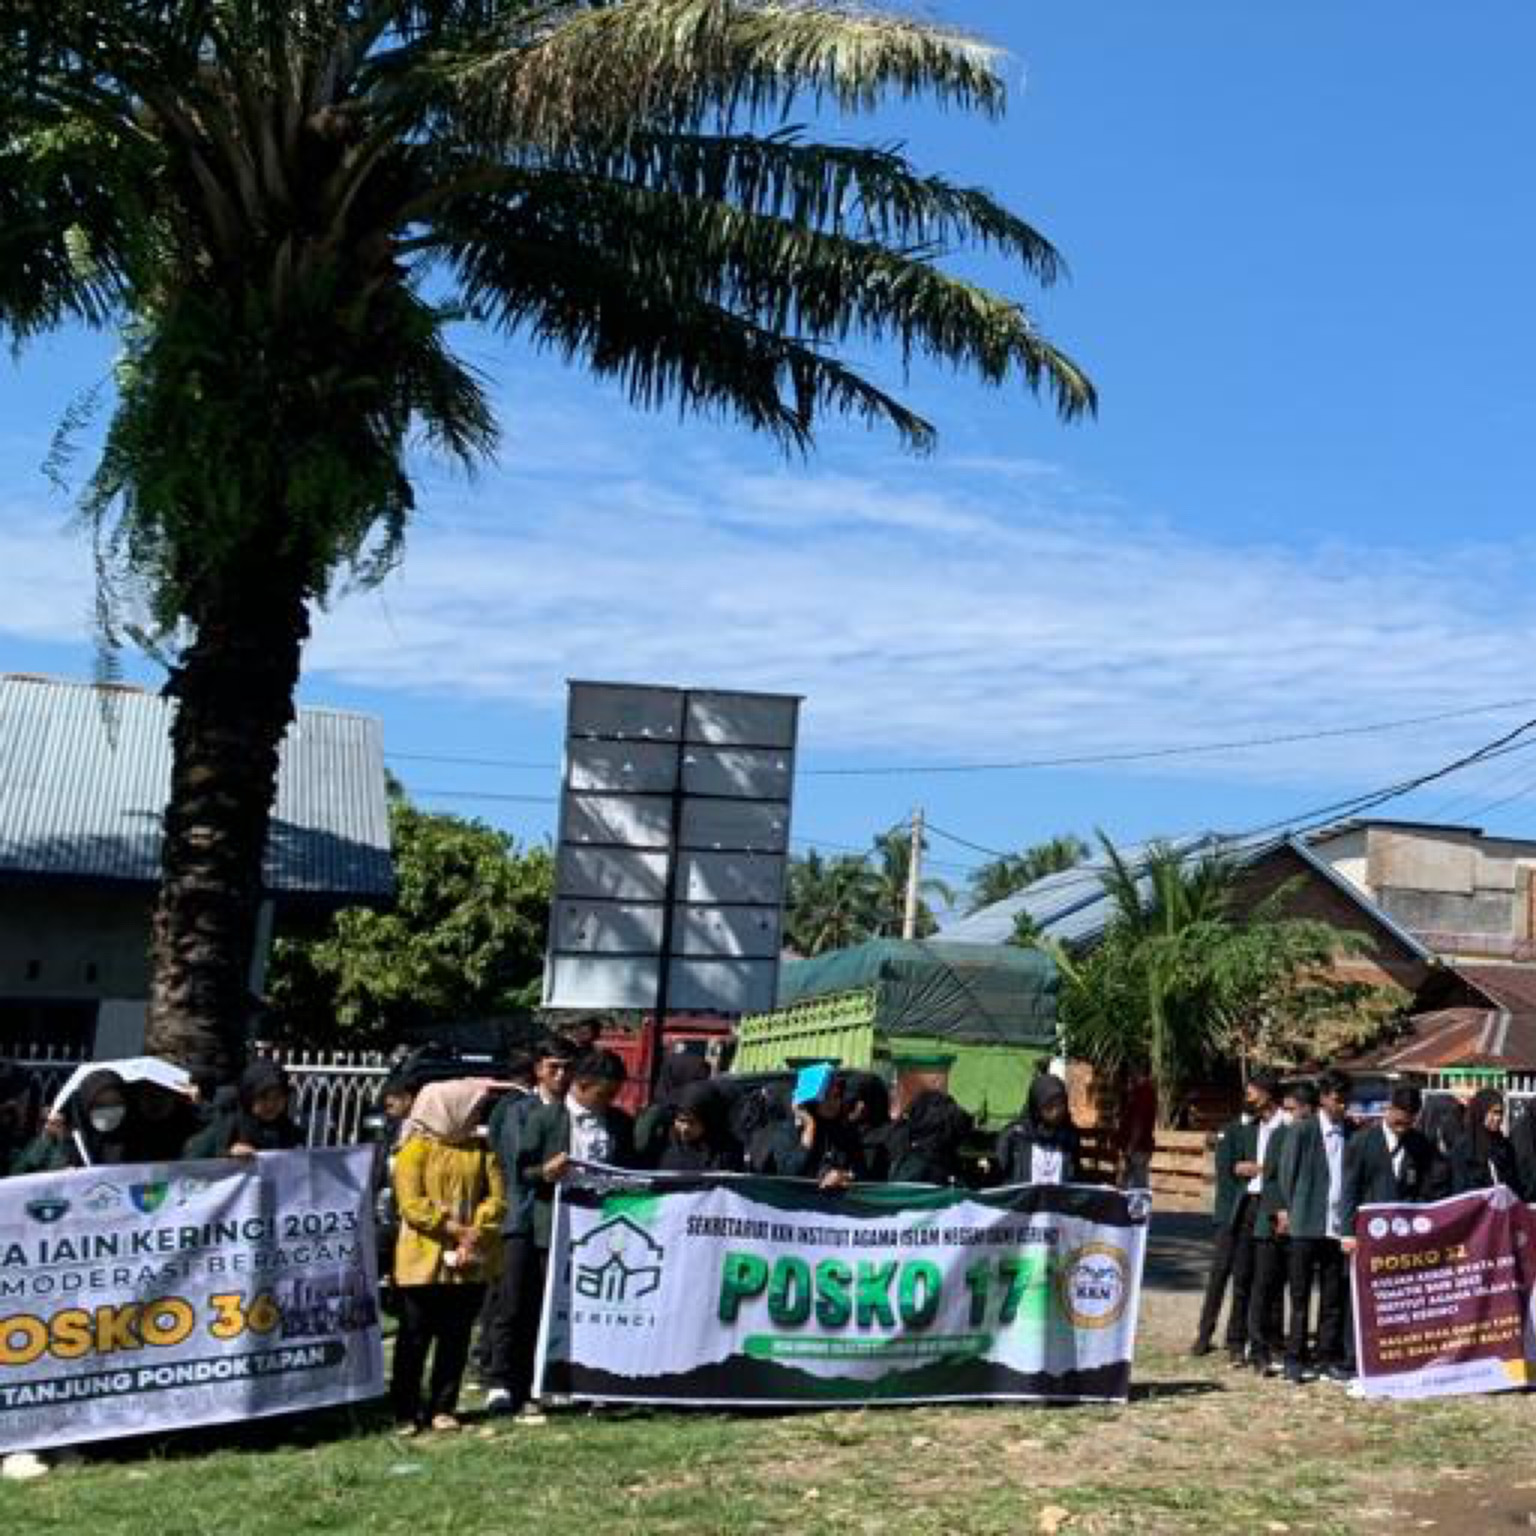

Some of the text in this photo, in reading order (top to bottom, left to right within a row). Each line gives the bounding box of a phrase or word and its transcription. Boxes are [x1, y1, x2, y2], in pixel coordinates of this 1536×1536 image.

[39, 1233, 118, 1263] IAIN
[131, 1217, 275, 1254] KERINCI
[285, 1211, 358, 1237] 2023
[854, 1229, 897, 1246] AGAMA
[901, 1227, 939, 1246] ISLAM
[2, 1262, 190, 1296] MODERASI
[1370, 1251, 1440, 1273] POSKO
[718, 1250, 1033, 1330] POSKO 17
[208, 1293, 279, 1340] 36
[4, 1345, 325, 1406] TANJUNG PONDOK TAPAN
